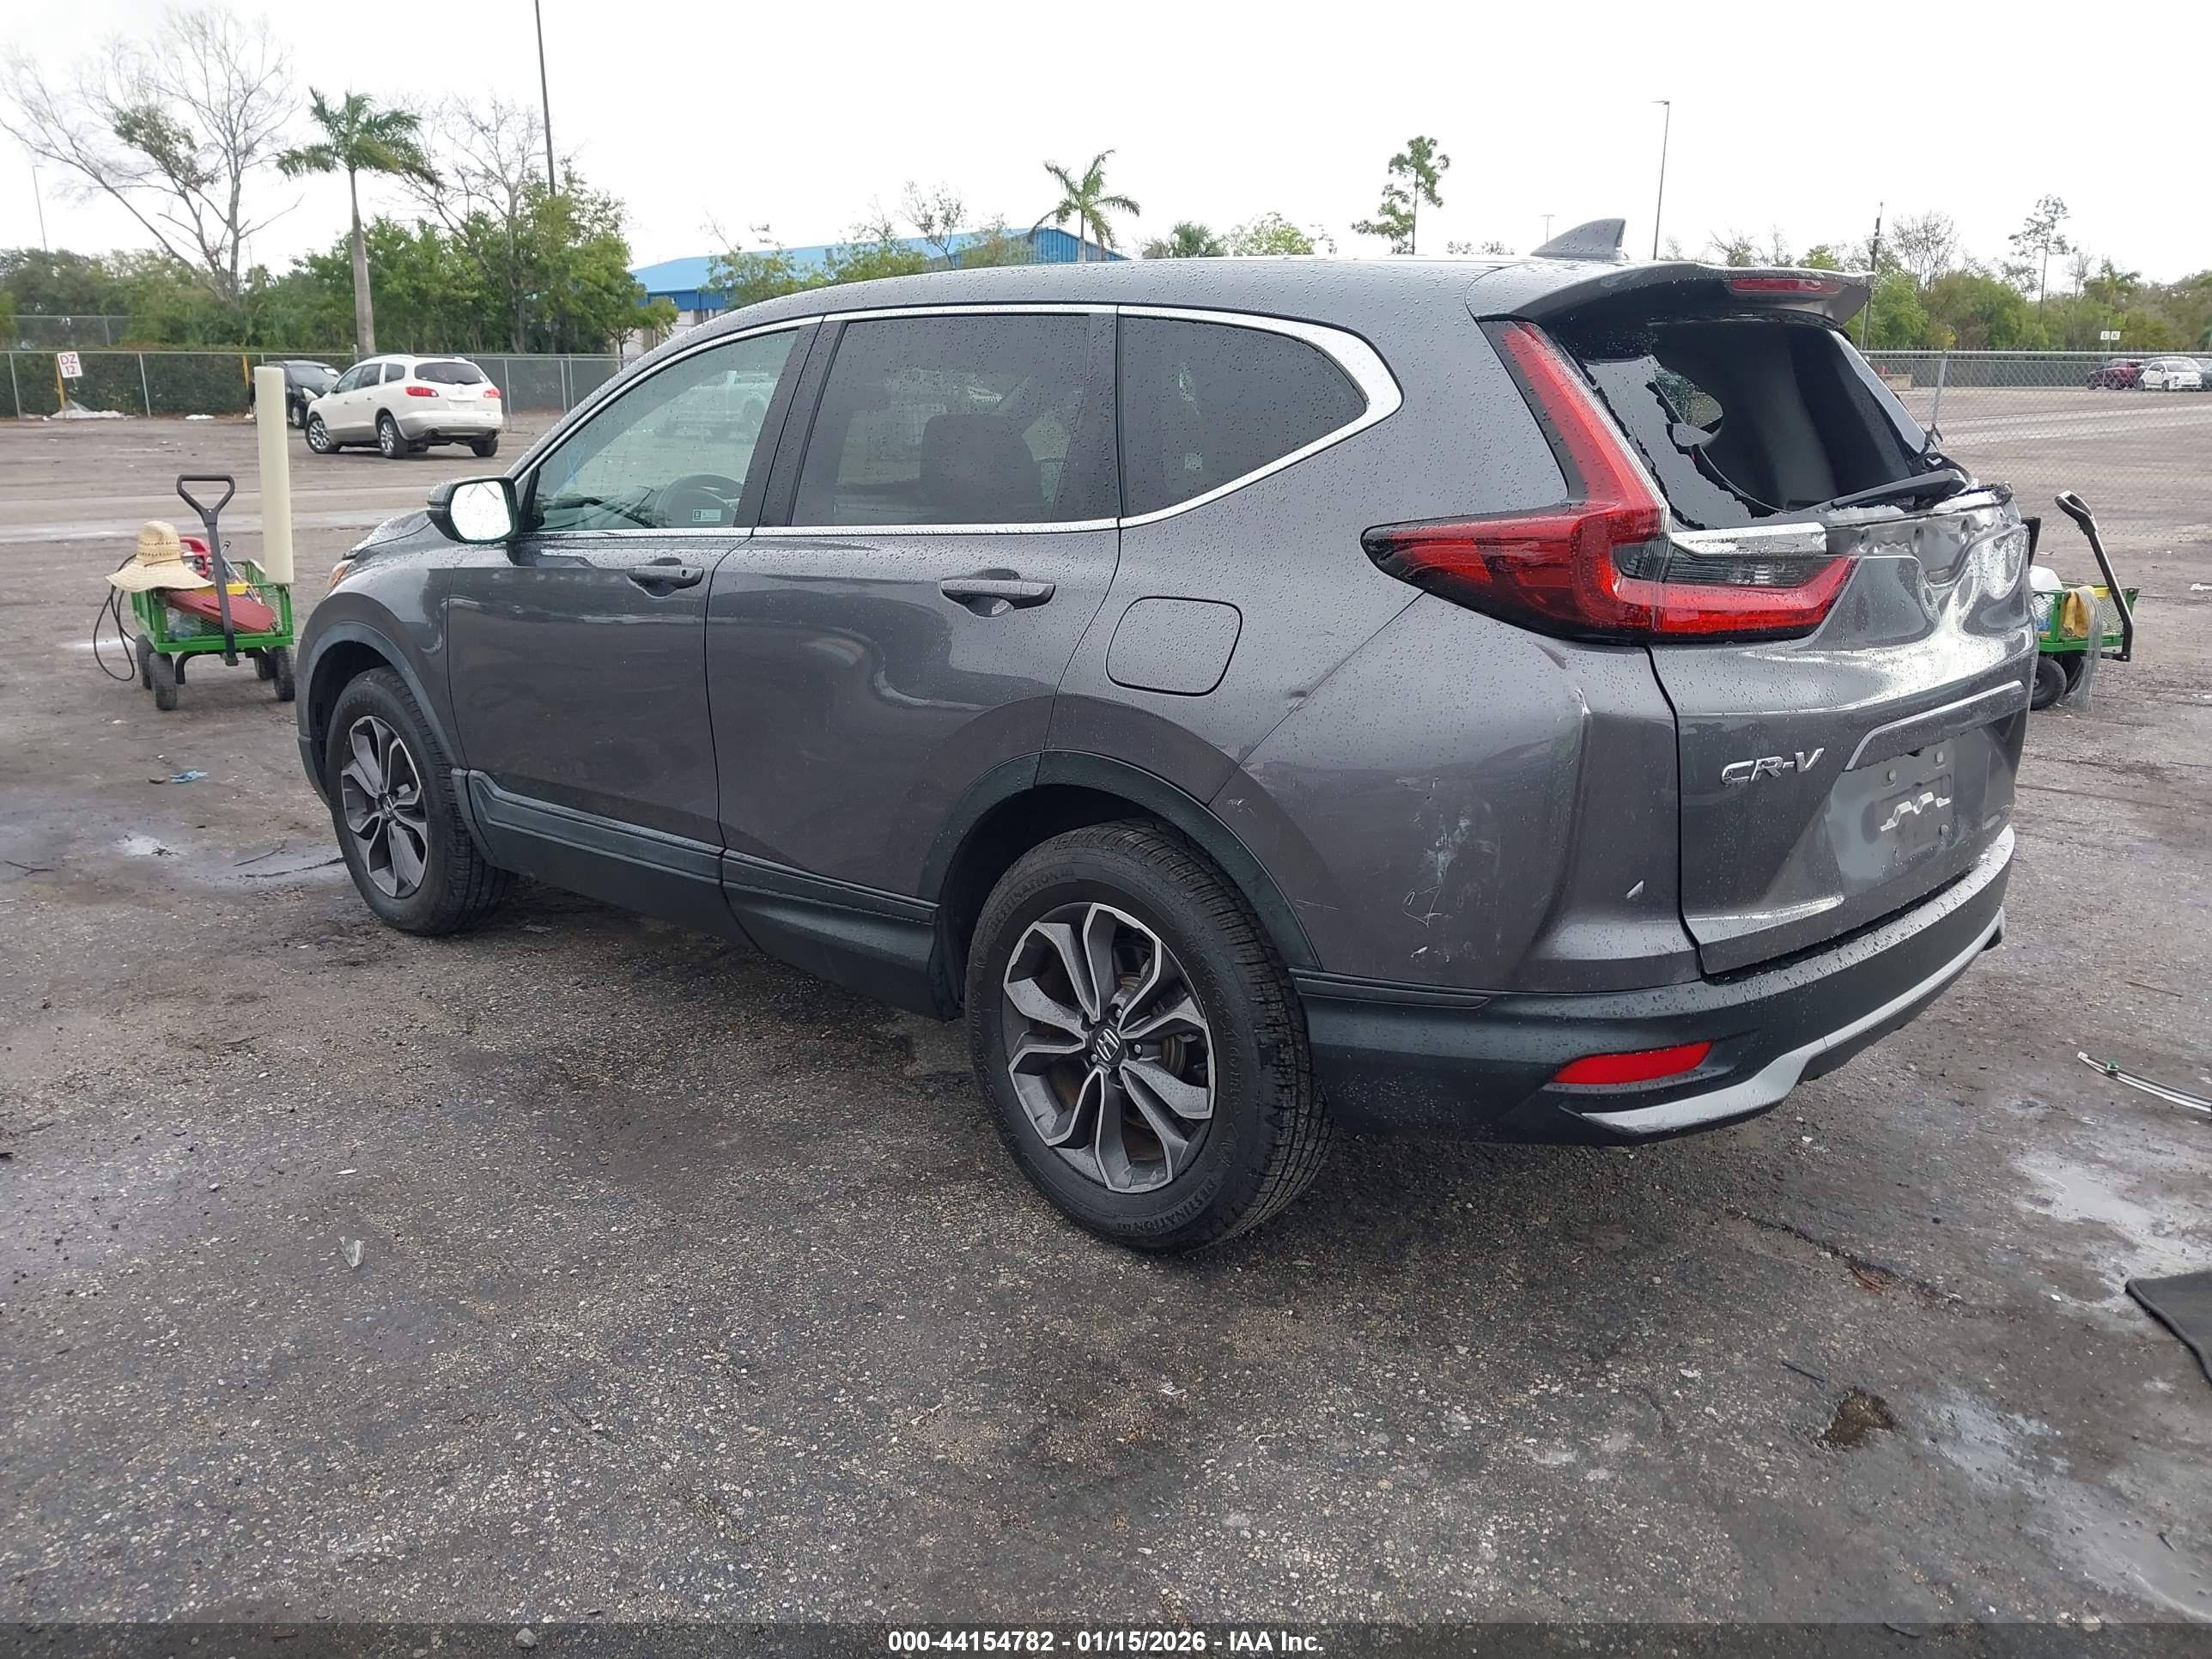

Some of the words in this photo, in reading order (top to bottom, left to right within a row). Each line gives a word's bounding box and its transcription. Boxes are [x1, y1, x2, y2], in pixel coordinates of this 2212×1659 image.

[60, 355, 77, 365] DZ
[65, 365, 76, 375] 12
[1721, 747, 1825, 785] CR-V
